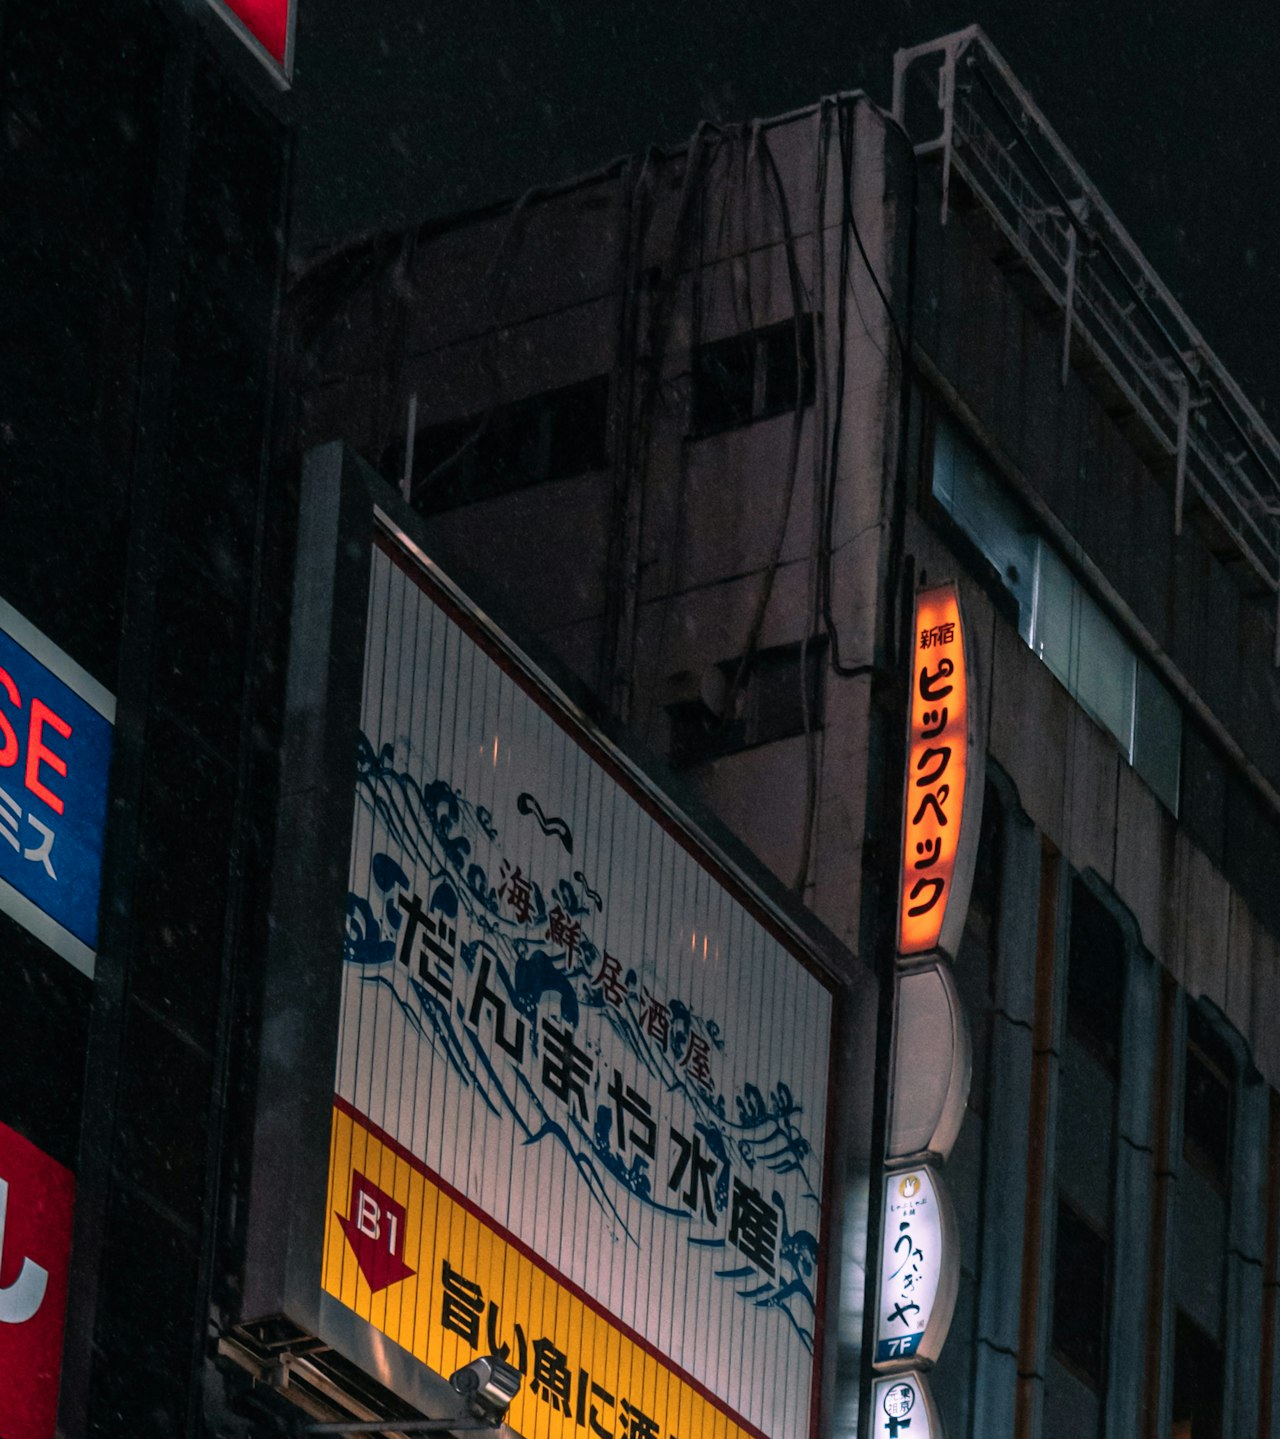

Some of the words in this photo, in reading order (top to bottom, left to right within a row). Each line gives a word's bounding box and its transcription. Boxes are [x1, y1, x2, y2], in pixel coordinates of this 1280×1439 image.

[920, 622, 955, 650] 新宿
[498, 857, 716, 1086] 海鮮居酒屋
[399, 891, 780, 1282] だんまや水産
[355, 1190, 403, 1257] B1
[887, 1338, 911, 1357] 7F
